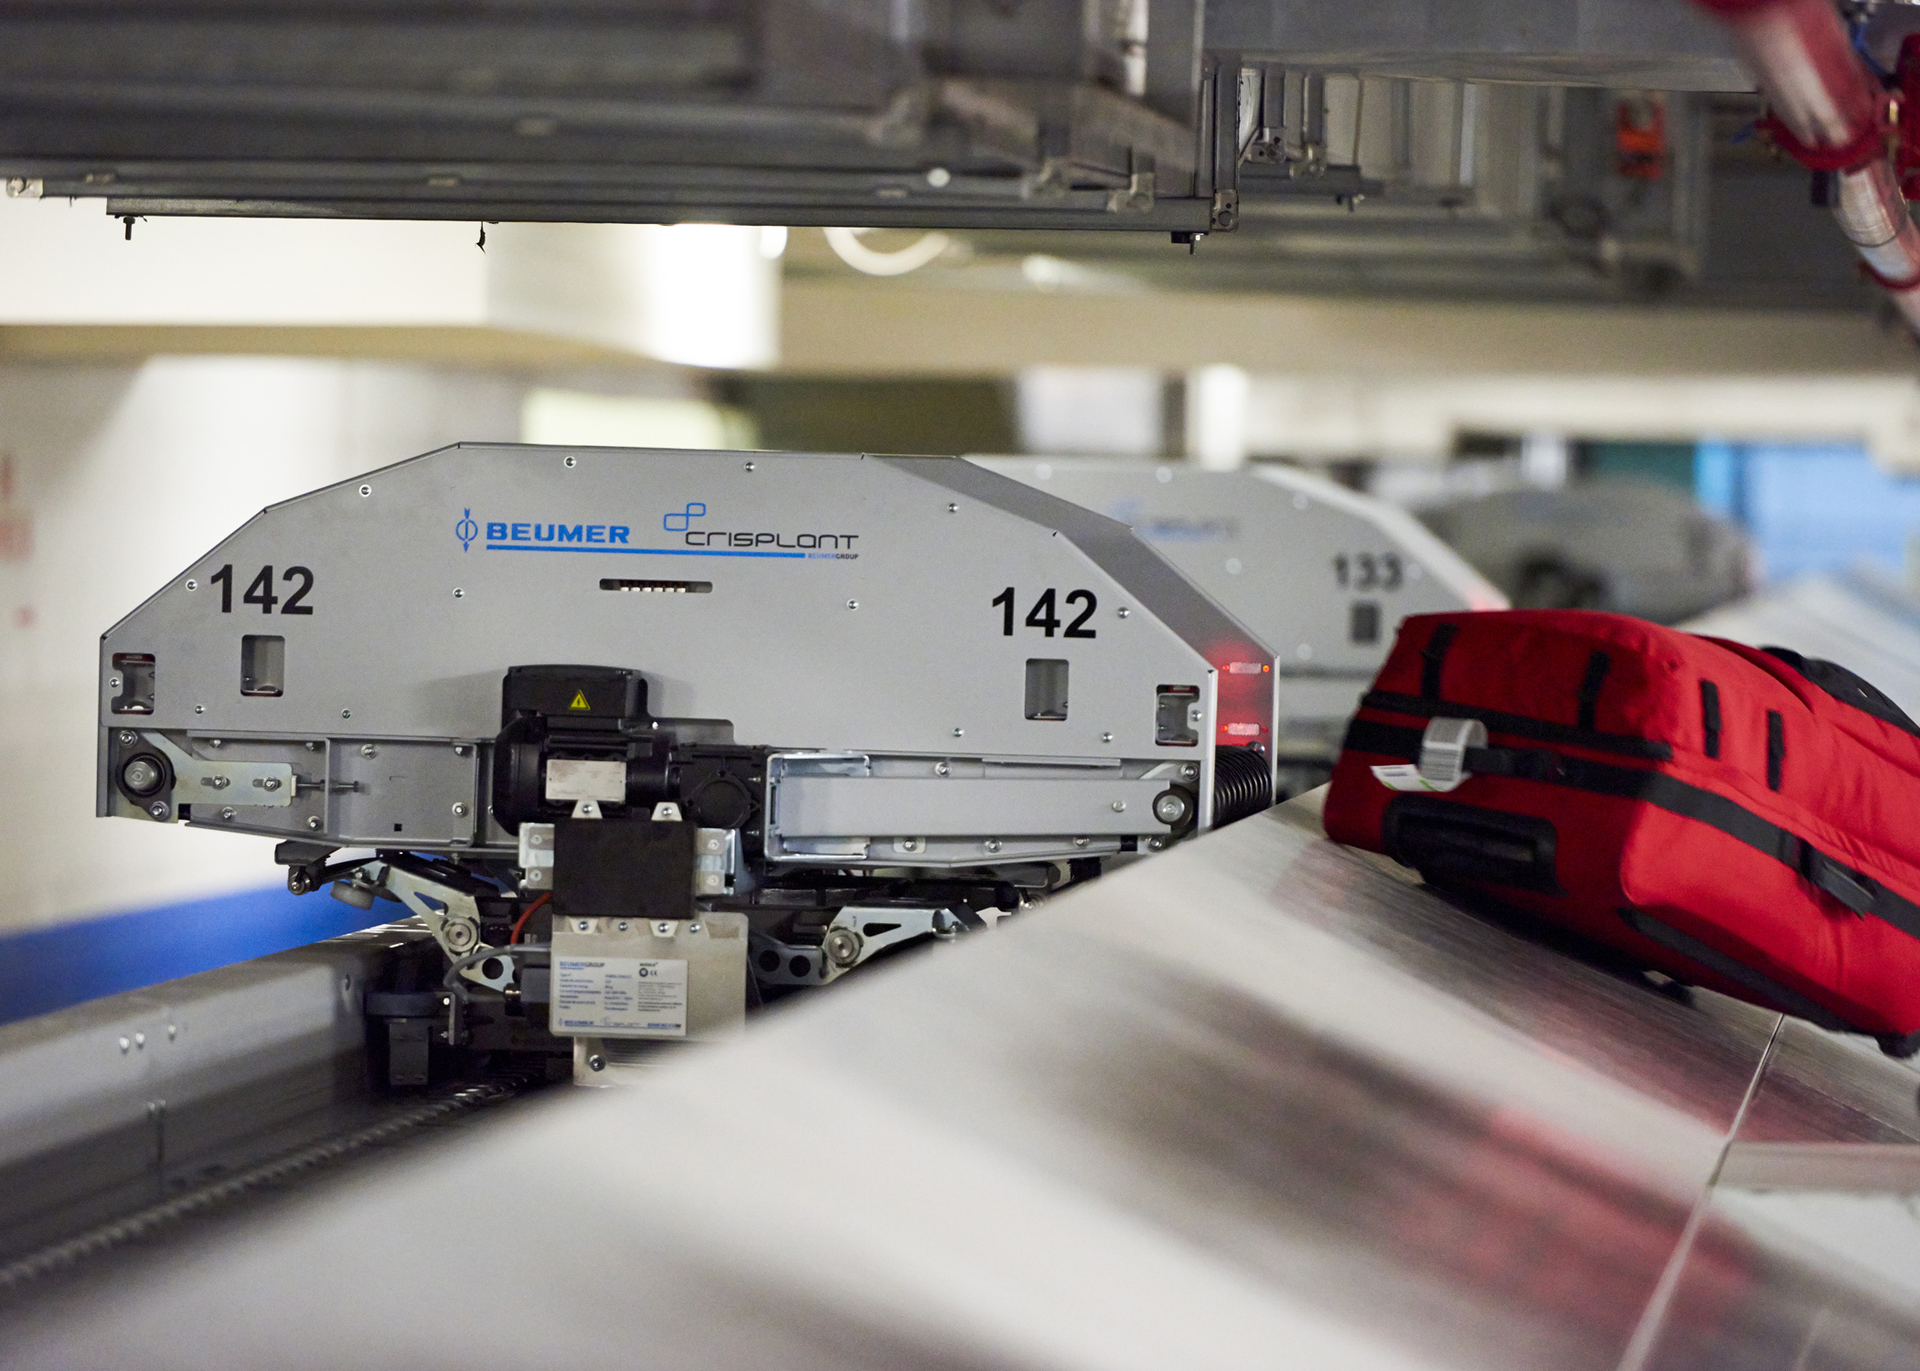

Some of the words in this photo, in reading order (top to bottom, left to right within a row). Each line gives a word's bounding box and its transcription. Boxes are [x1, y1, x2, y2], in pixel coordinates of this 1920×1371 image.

[486, 523, 630, 545] BEUMER
[210, 564, 314, 615] 142
[1334, 552, 1403, 590] 133
[992, 586, 1097, 638] 142
